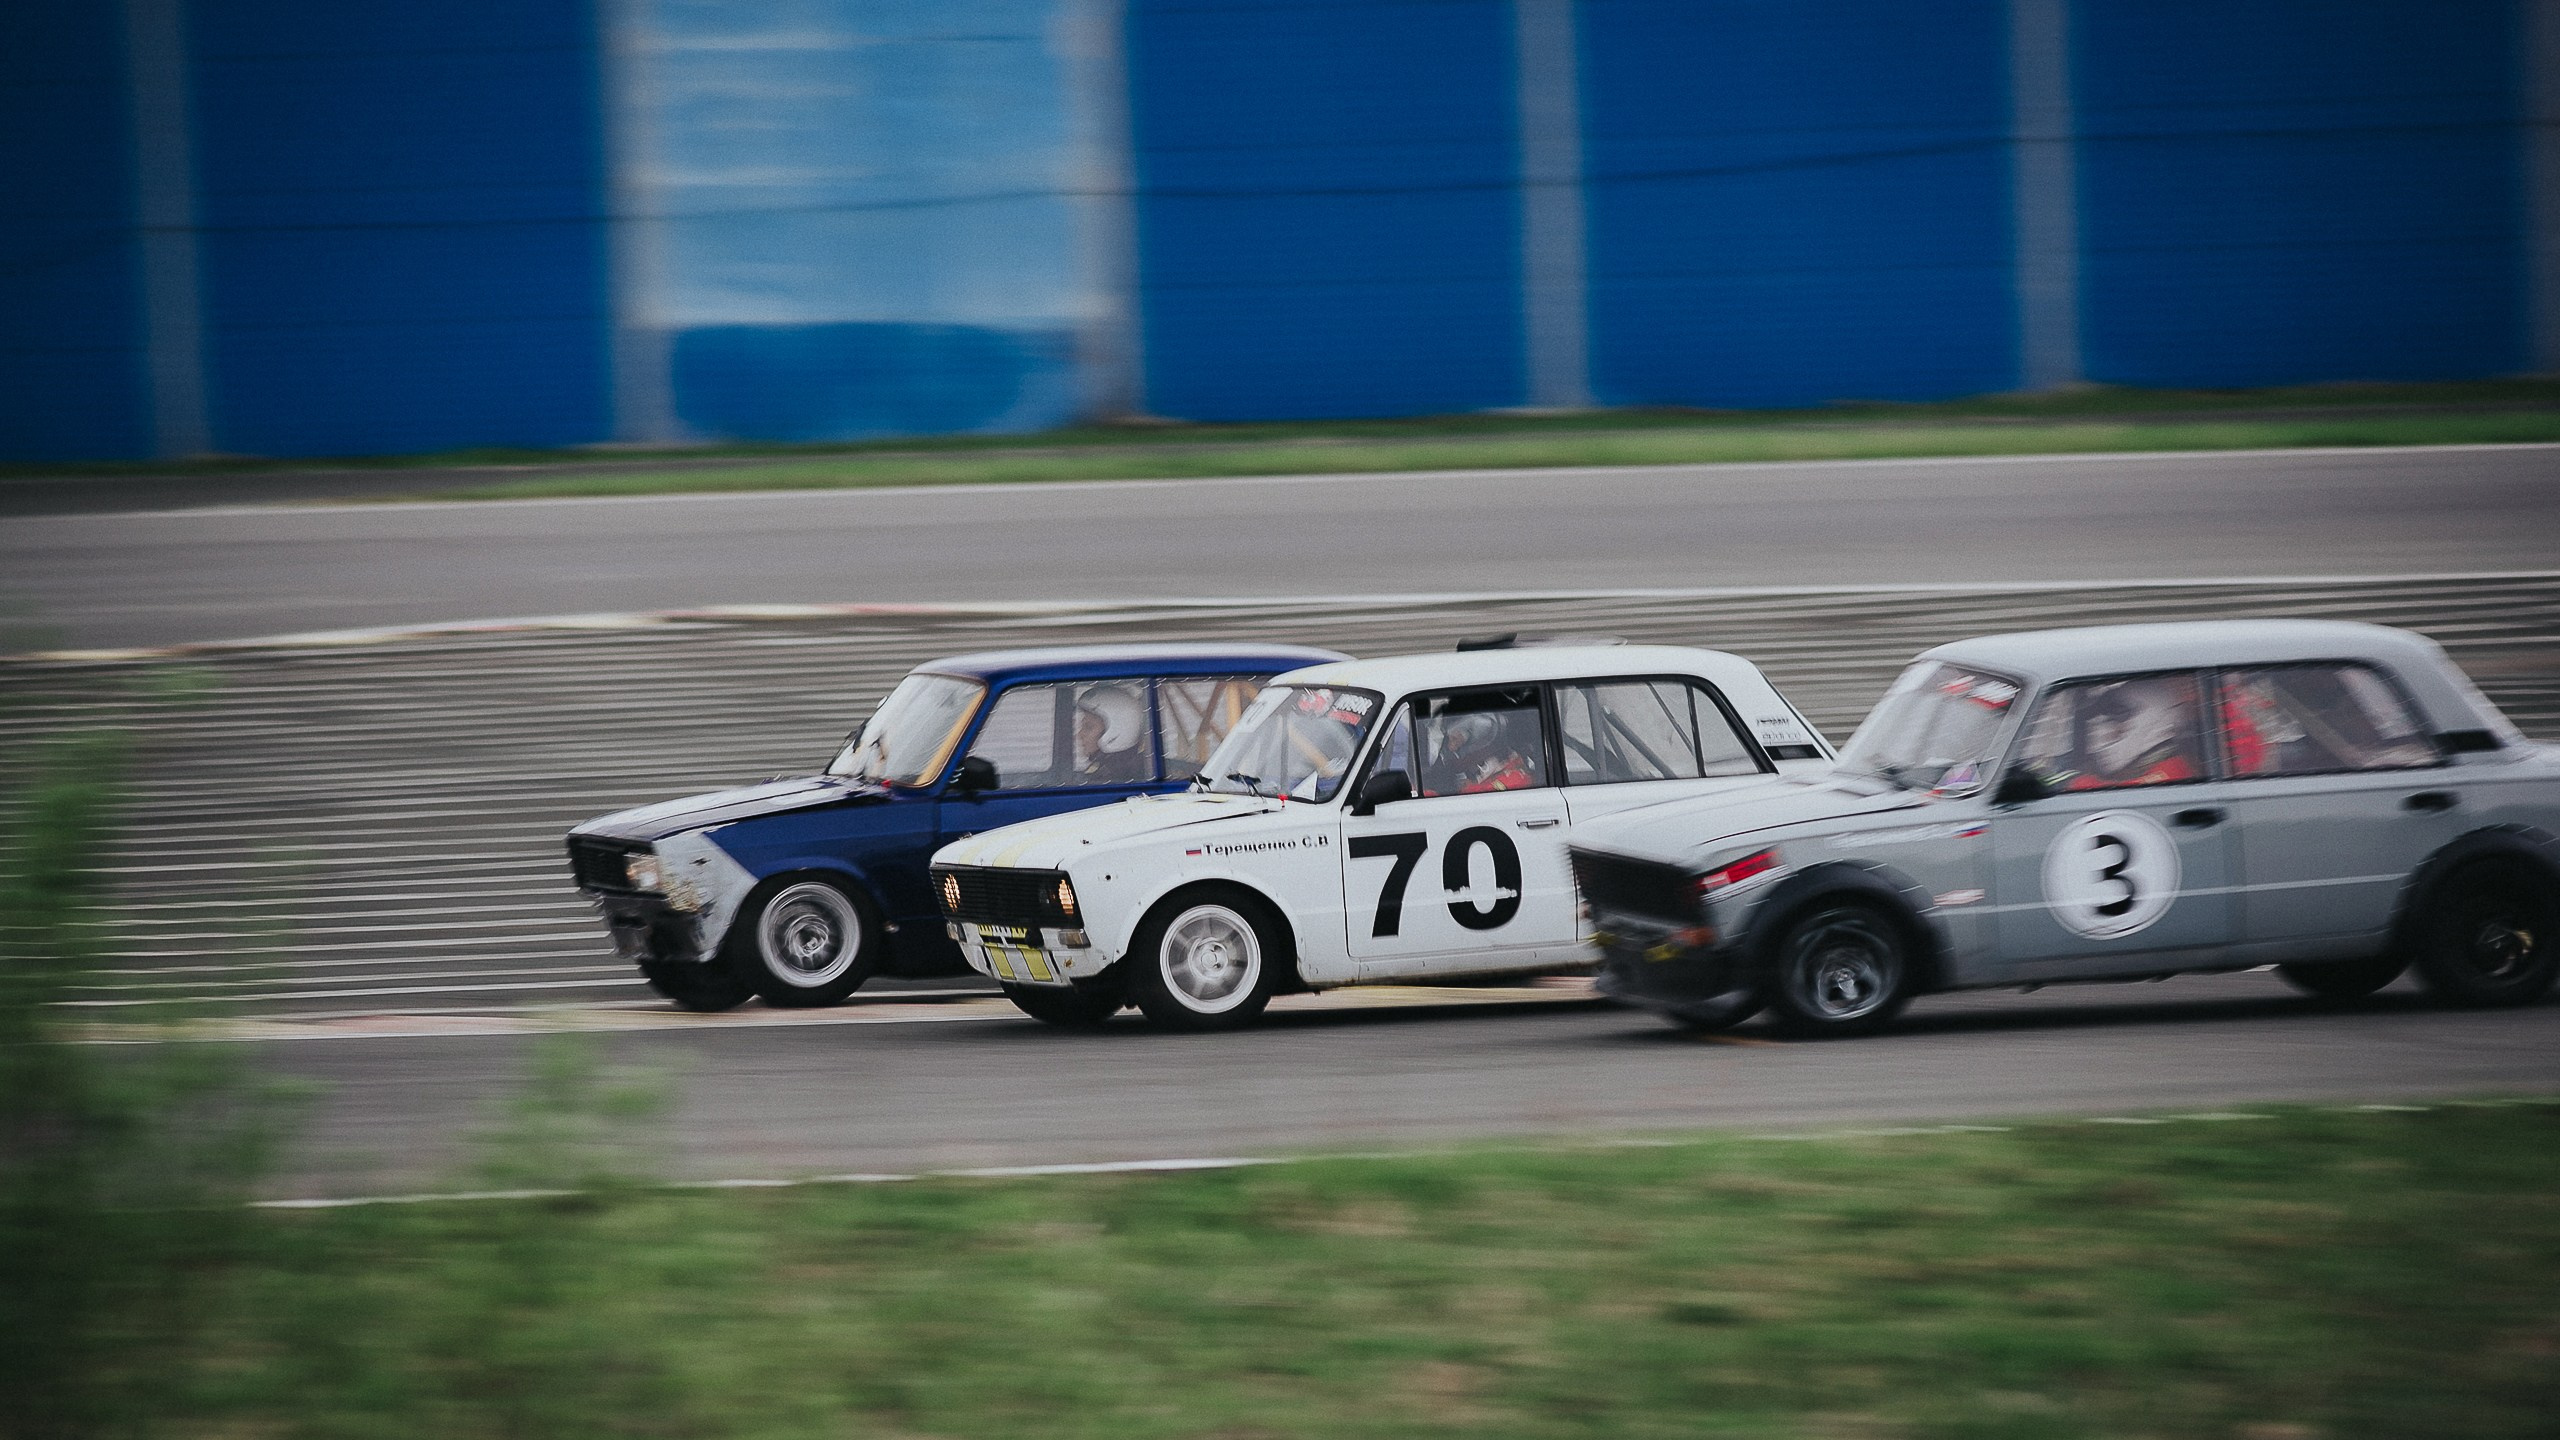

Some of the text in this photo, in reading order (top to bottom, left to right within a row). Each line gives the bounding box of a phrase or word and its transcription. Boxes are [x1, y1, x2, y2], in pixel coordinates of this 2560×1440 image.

[1204, 838, 1297, 857] Терещенко
[1348, 826, 1522, 938] 70
[2090, 834, 2137, 917] 3
